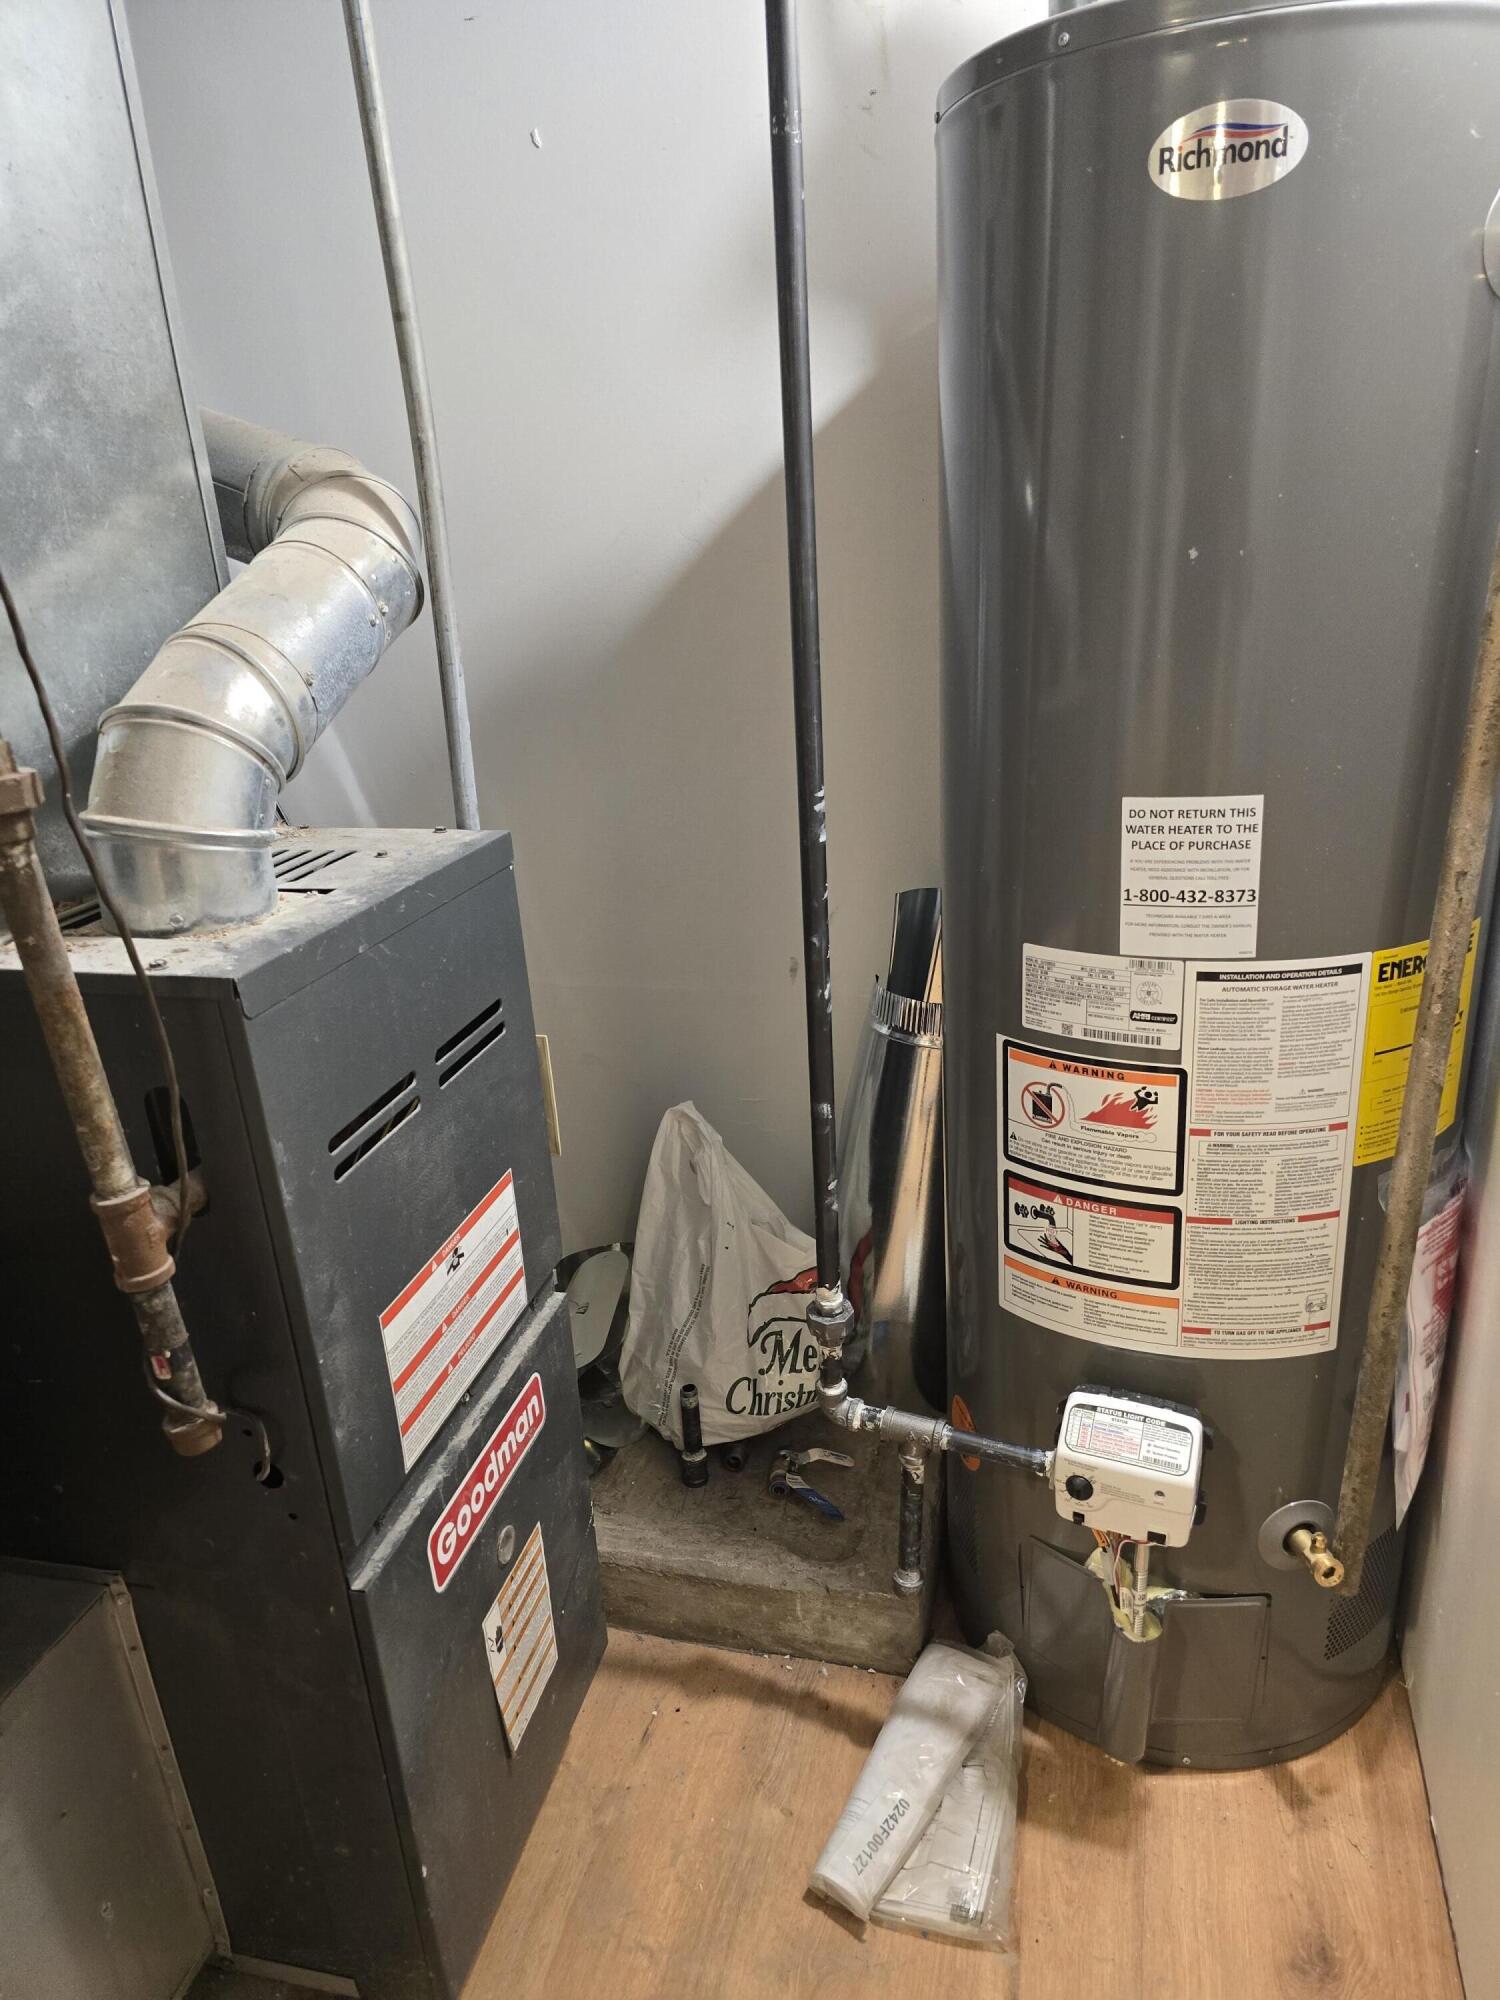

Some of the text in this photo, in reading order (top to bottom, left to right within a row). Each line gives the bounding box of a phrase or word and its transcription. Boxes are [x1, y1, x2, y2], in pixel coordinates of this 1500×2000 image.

[1129, 808, 1256, 819] DO NOT RETURN THIS
[1126, 823, 1259, 835] WATER HEATER TO THE
[1131, 840, 1251, 850] PLACE OF PURCHASE
[1123, 888, 1256, 903] 1-800-432-8373
[1281, 970, 1317, 979] OPERATION
[1378, 954, 1427, 982] ENER
[1315, 981, 1339, 989] HEATER
[1063, 1063, 1125, 1081] WARNING
[1117, 1131, 1139, 1139] Vapors
[1066, 1199, 1117, 1215] DANGER
[1066, 1280, 1118, 1299] WARNING
[758, 1328, 821, 1376] Me
[437, 1395, 540, 1565] Goodman
[854, 1798, 910, 1877] 0242F00127
